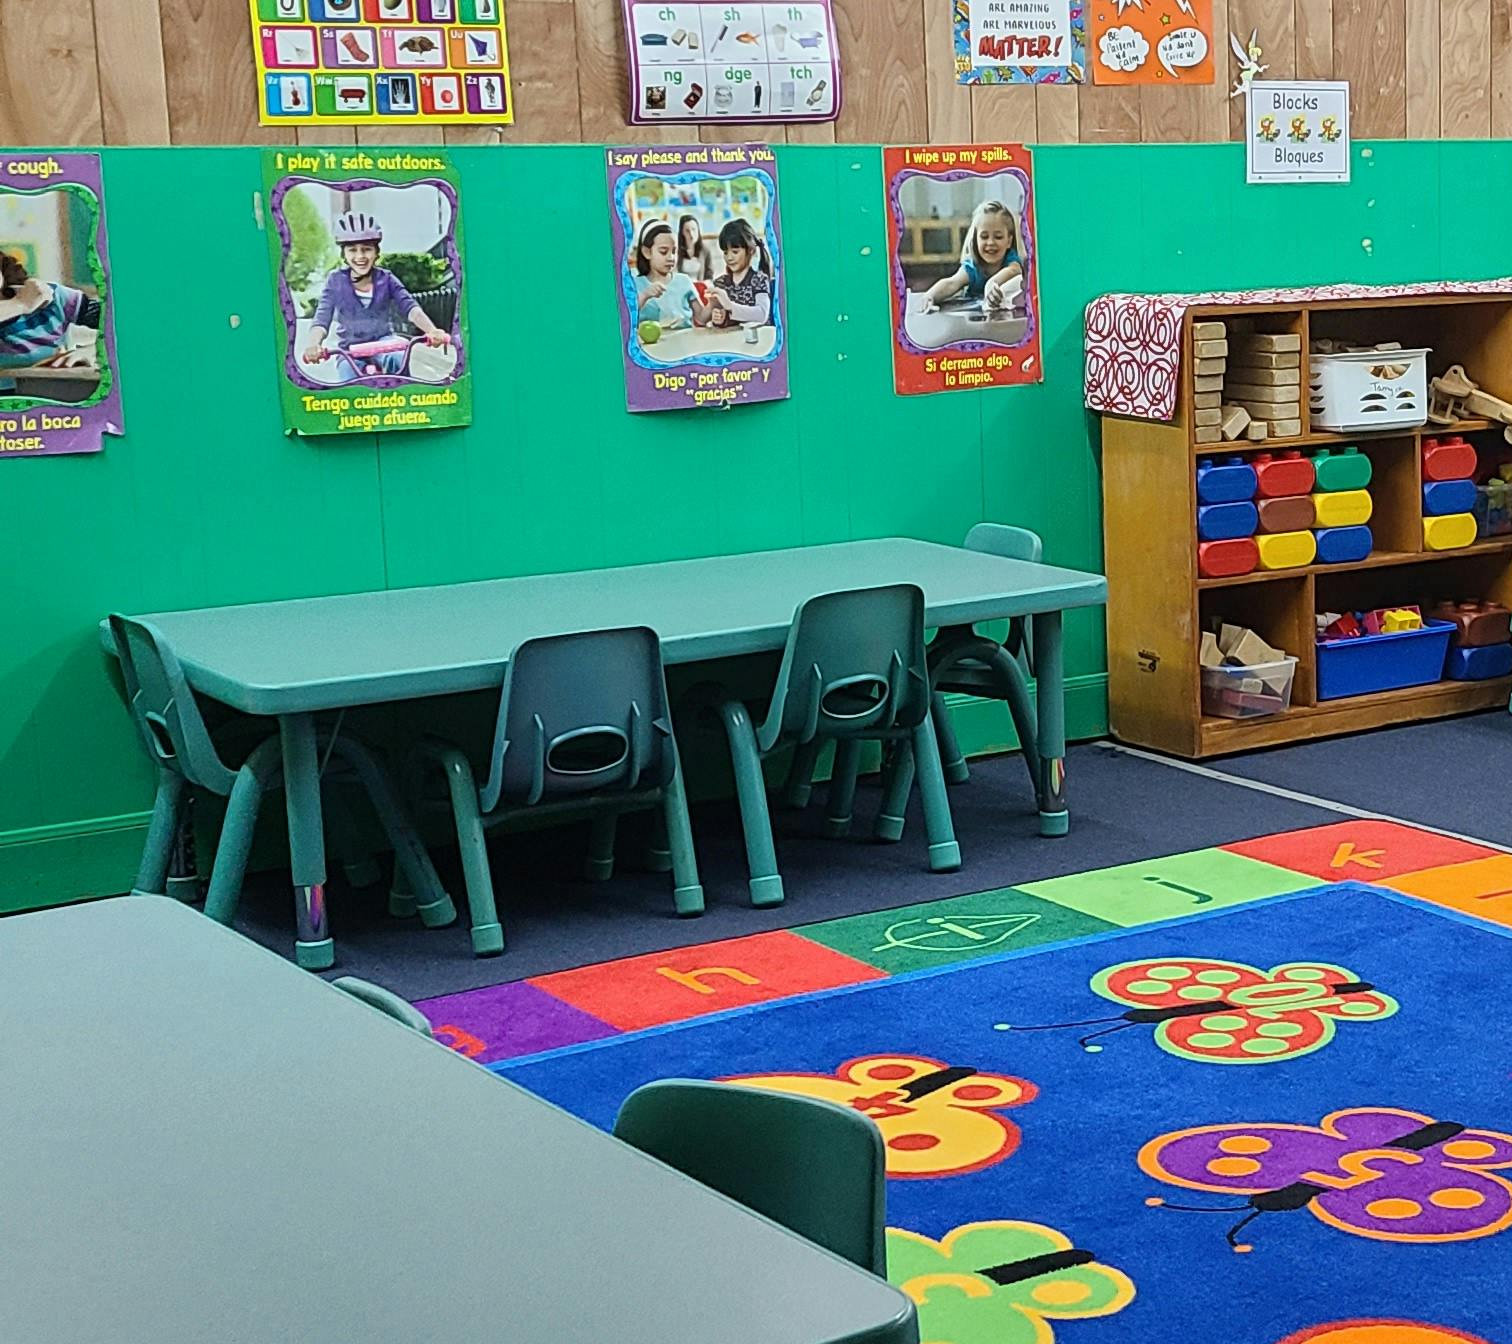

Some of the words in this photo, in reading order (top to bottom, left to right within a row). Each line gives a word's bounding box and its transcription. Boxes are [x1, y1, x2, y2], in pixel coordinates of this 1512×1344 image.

[659, 7, 676, 21] ch
[724, 8, 740, 22] sh
[788, 8, 802, 21] th
[989, 3, 1005, 12] ARE
[1010, 3, 1049, 13] AMAZING
[983, 20, 1000, 29] ARE
[1004, 20, 1056, 30] MARVELOUS
[978, 34, 1063, 61] MATTER!
[376, 76, 389, 84] Xx
[420, 76, 431, 86] Yy
[466, 76, 477, 85] Zz
[664, 71, 682, 85] ng
[725, 67, 752, 84] dge
[790, 66, 812, 79] tch
[1273, 92, 1318, 110] Blocks
[276, 153, 284, 169] I
[288, 153, 320, 172] play
[325, 153, 336, 169] it
[342, 153, 373, 169] safe
[377, 154, 446, 170] outdoors.
[608, 151, 613, 165] I
[615, 153, 637, 168] say
[642, 150, 681, 167] please
[686, 148, 708, 163] and
[712, 148, 745, 162] thank
[749, 149, 774, 164] you.
[905, 149, 910, 164] I
[913, 148, 939, 166] wipe
[942, 152, 957, 165] up
[960, 151, 977, 164] my
[981, 147, 1012, 164] spills.
[1274, 147, 1324, 167] Bloques
[7, 156, 64, 178] cough.
[925, 358, 936, 372] Si
[940, 357, 983, 371] derramo
[654, 373, 686, 391] Digo
[762, 368, 770, 382] y
[946, 371, 956, 385] lo
[959, 369, 994, 386] limpio.
[302, 396, 350, 414] Tengo
[354, 392, 406, 409] cuidado
[410, 389, 457, 406] cuando
[22, 414, 36, 431] la
[42, 414, 81, 430] boca
[338, 412, 380, 431] juego
[384, 409, 431, 424] afuera.
[0, 435, 45, 451] toser.
[1331, 843, 1385, 868] k
[1144, 876, 1213, 905] j
[656, 967, 760, 995] h
